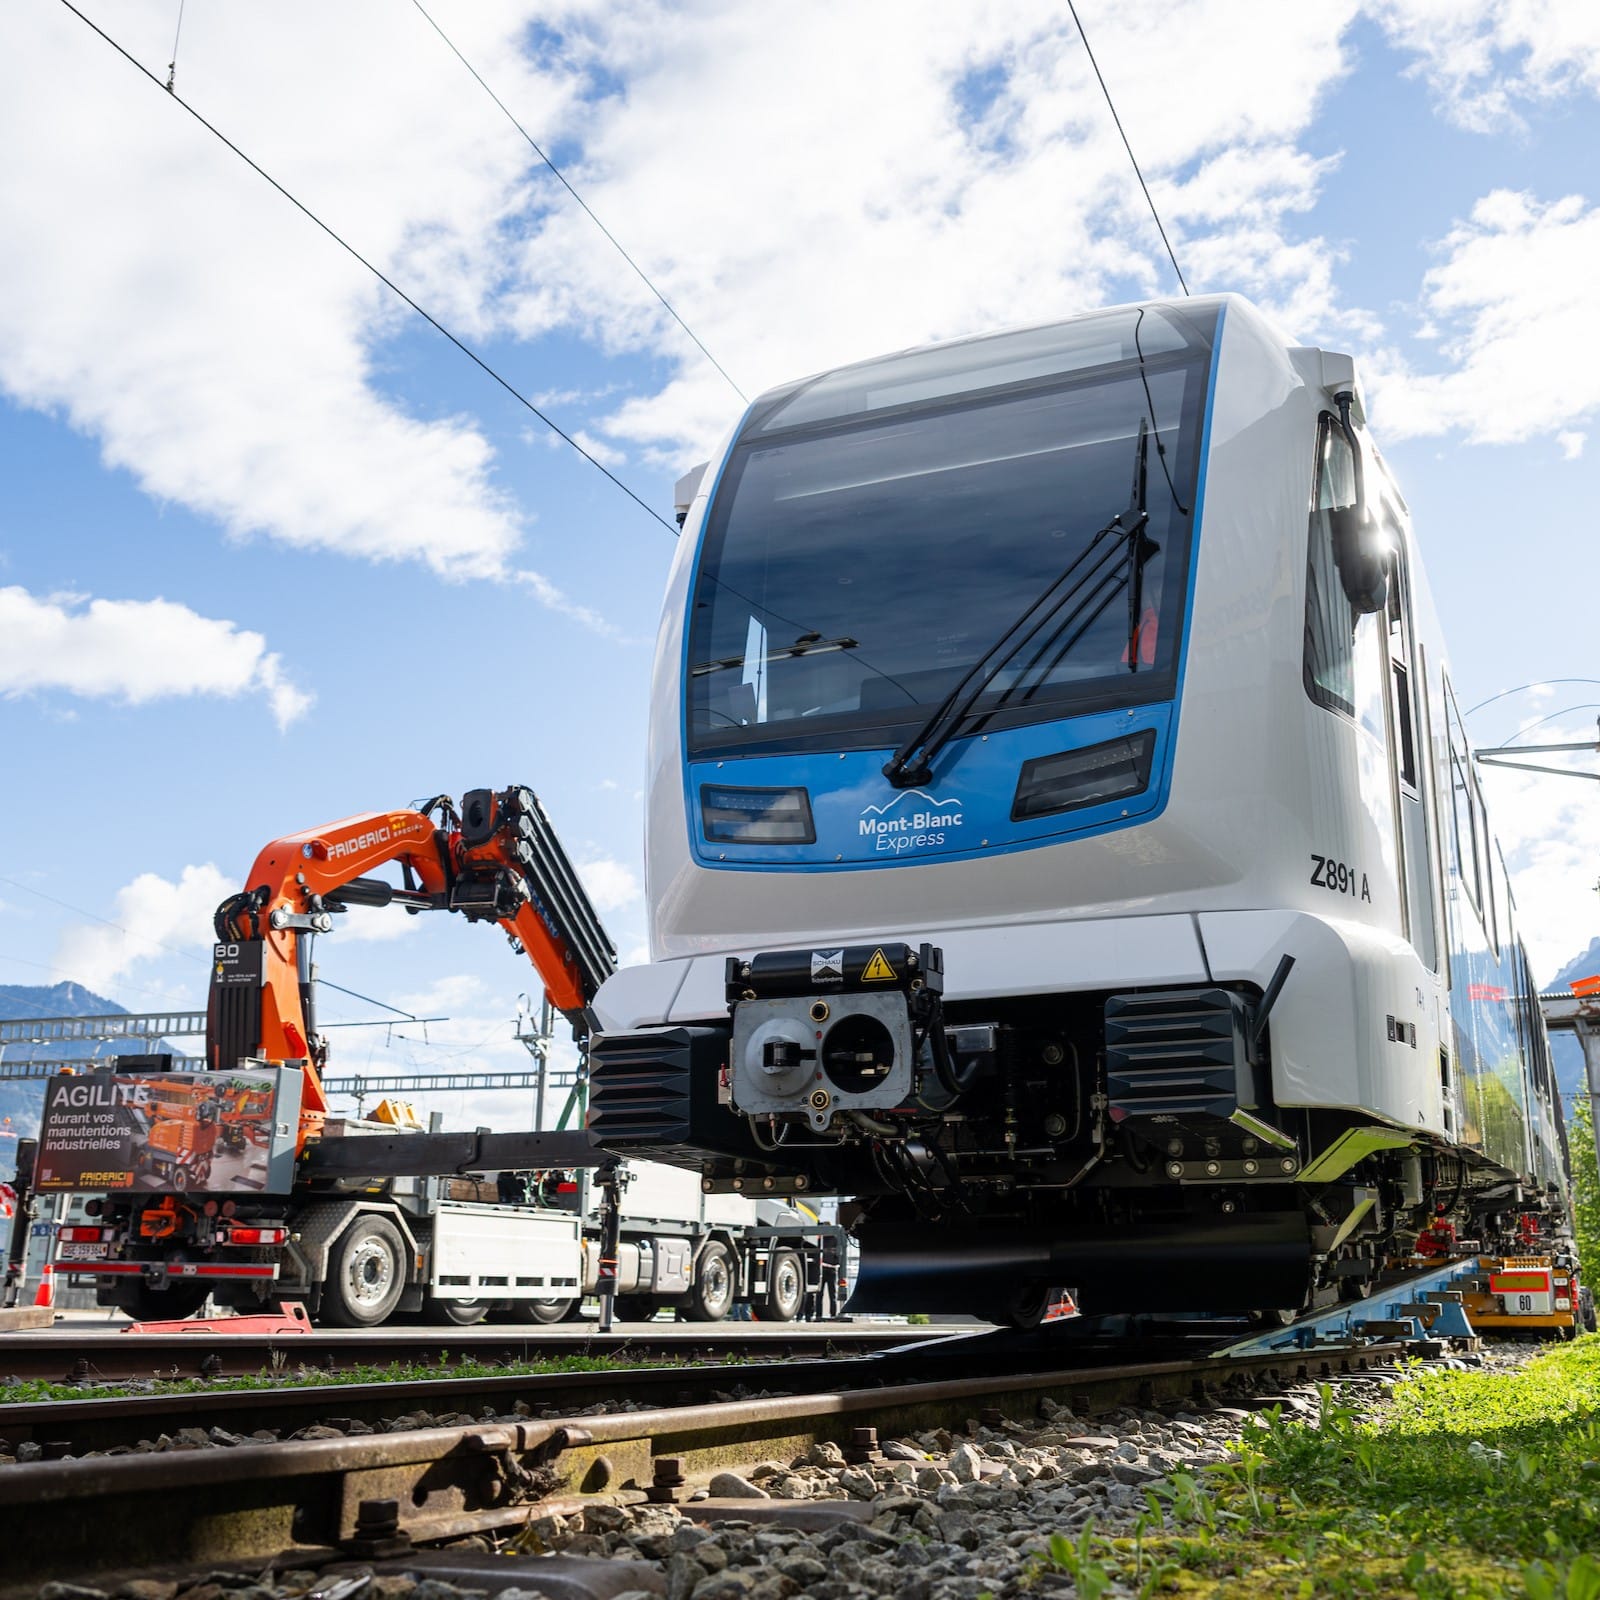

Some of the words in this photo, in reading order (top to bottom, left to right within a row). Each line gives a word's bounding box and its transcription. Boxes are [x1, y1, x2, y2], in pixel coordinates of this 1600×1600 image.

[859, 811, 963, 836] Mont-Blanc
[326, 826, 391, 862] FRIDERICI
[875, 832, 945, 855] Express
[1310, 853, 1356, 897] Z891
[1361, 872, 1372, 904] A
[49, 1112, 91, 1125] durant
[93, 1113, 115, 1124] vos
[47, 1124, 132, 1137] manutentions
[46, 1137, 121, 1151] industrielles
[79, 1172, 127, 1181] FRIDERICI
[1519, 1294, 1532, 1311] 60
